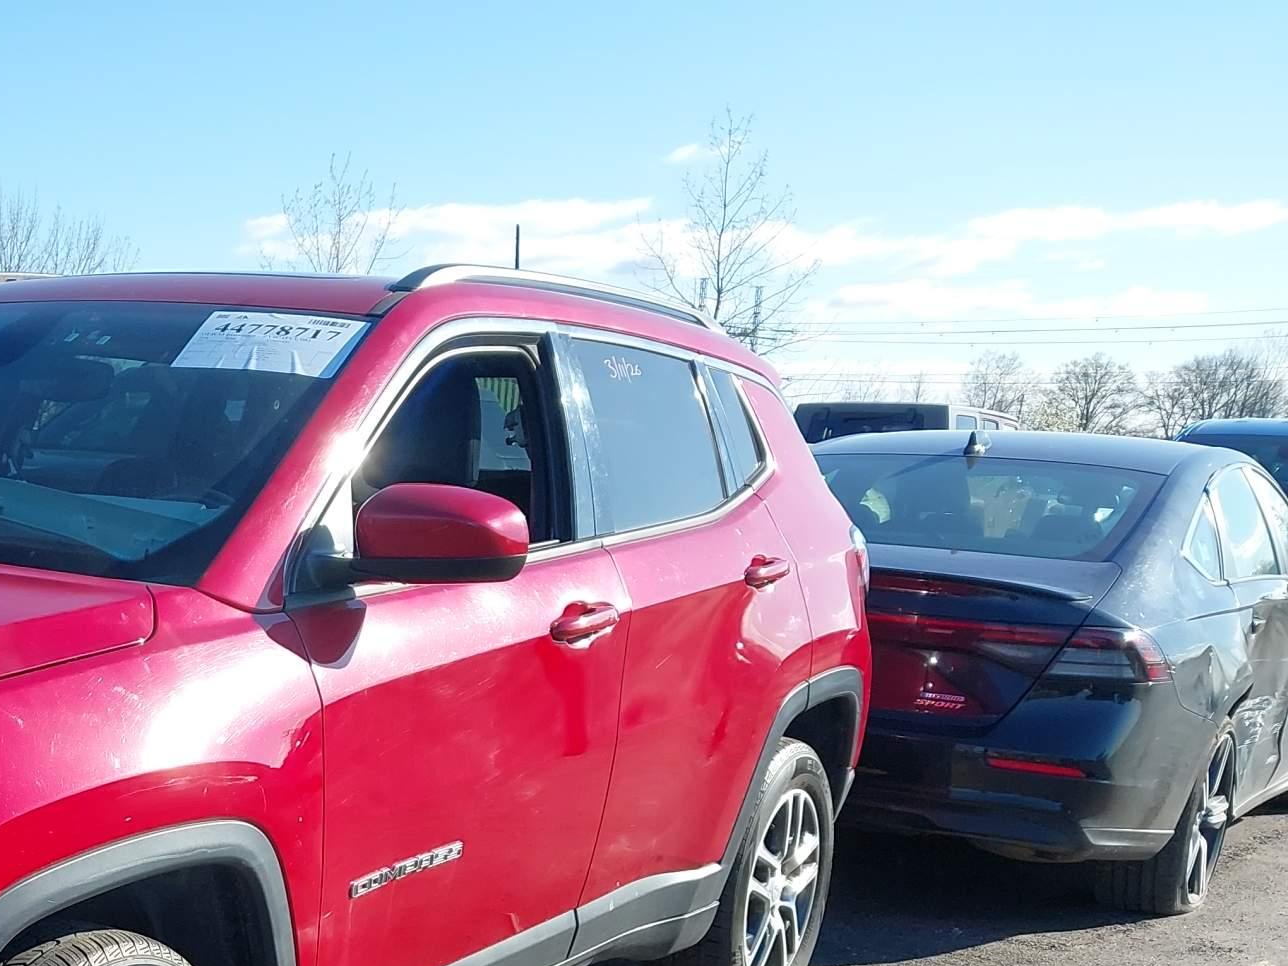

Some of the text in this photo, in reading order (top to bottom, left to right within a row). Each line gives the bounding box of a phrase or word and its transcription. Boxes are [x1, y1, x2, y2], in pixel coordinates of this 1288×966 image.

[214, 322, 342, 341] 44778717
[913, 699, 966, 709] SPORT
[349, 840, 463, 898] COMPASS
